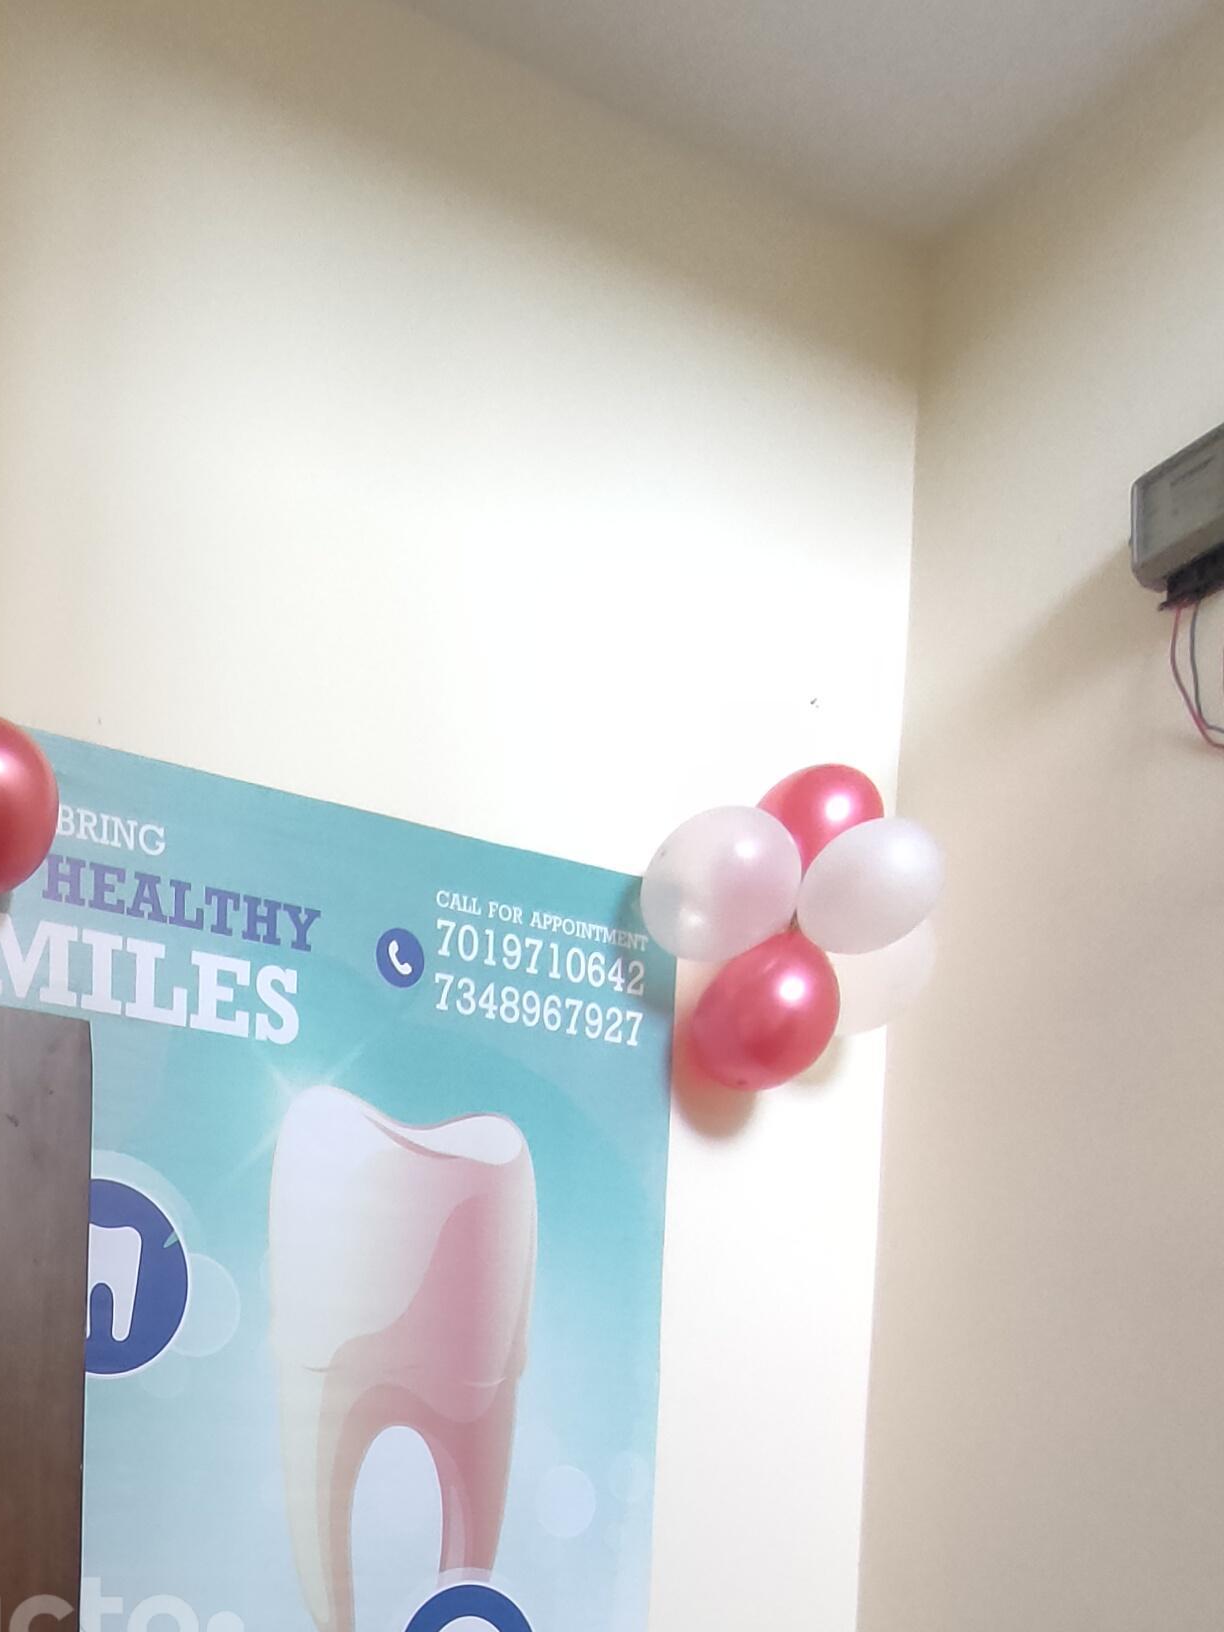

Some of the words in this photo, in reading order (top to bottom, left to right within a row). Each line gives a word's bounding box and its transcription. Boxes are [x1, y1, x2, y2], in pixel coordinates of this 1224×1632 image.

[56, 804, 166, 856] BRING
[42, 854, 321, 952] HEALTHY
[436, 890, 482, 916] CALL
[488, 901, 523, 925] FOR
[530, 911, 648, 952] APPOINTMENT
[436, 919, 645, 996] 7019710642
[434, 972, 643, 1046] 7348967927
